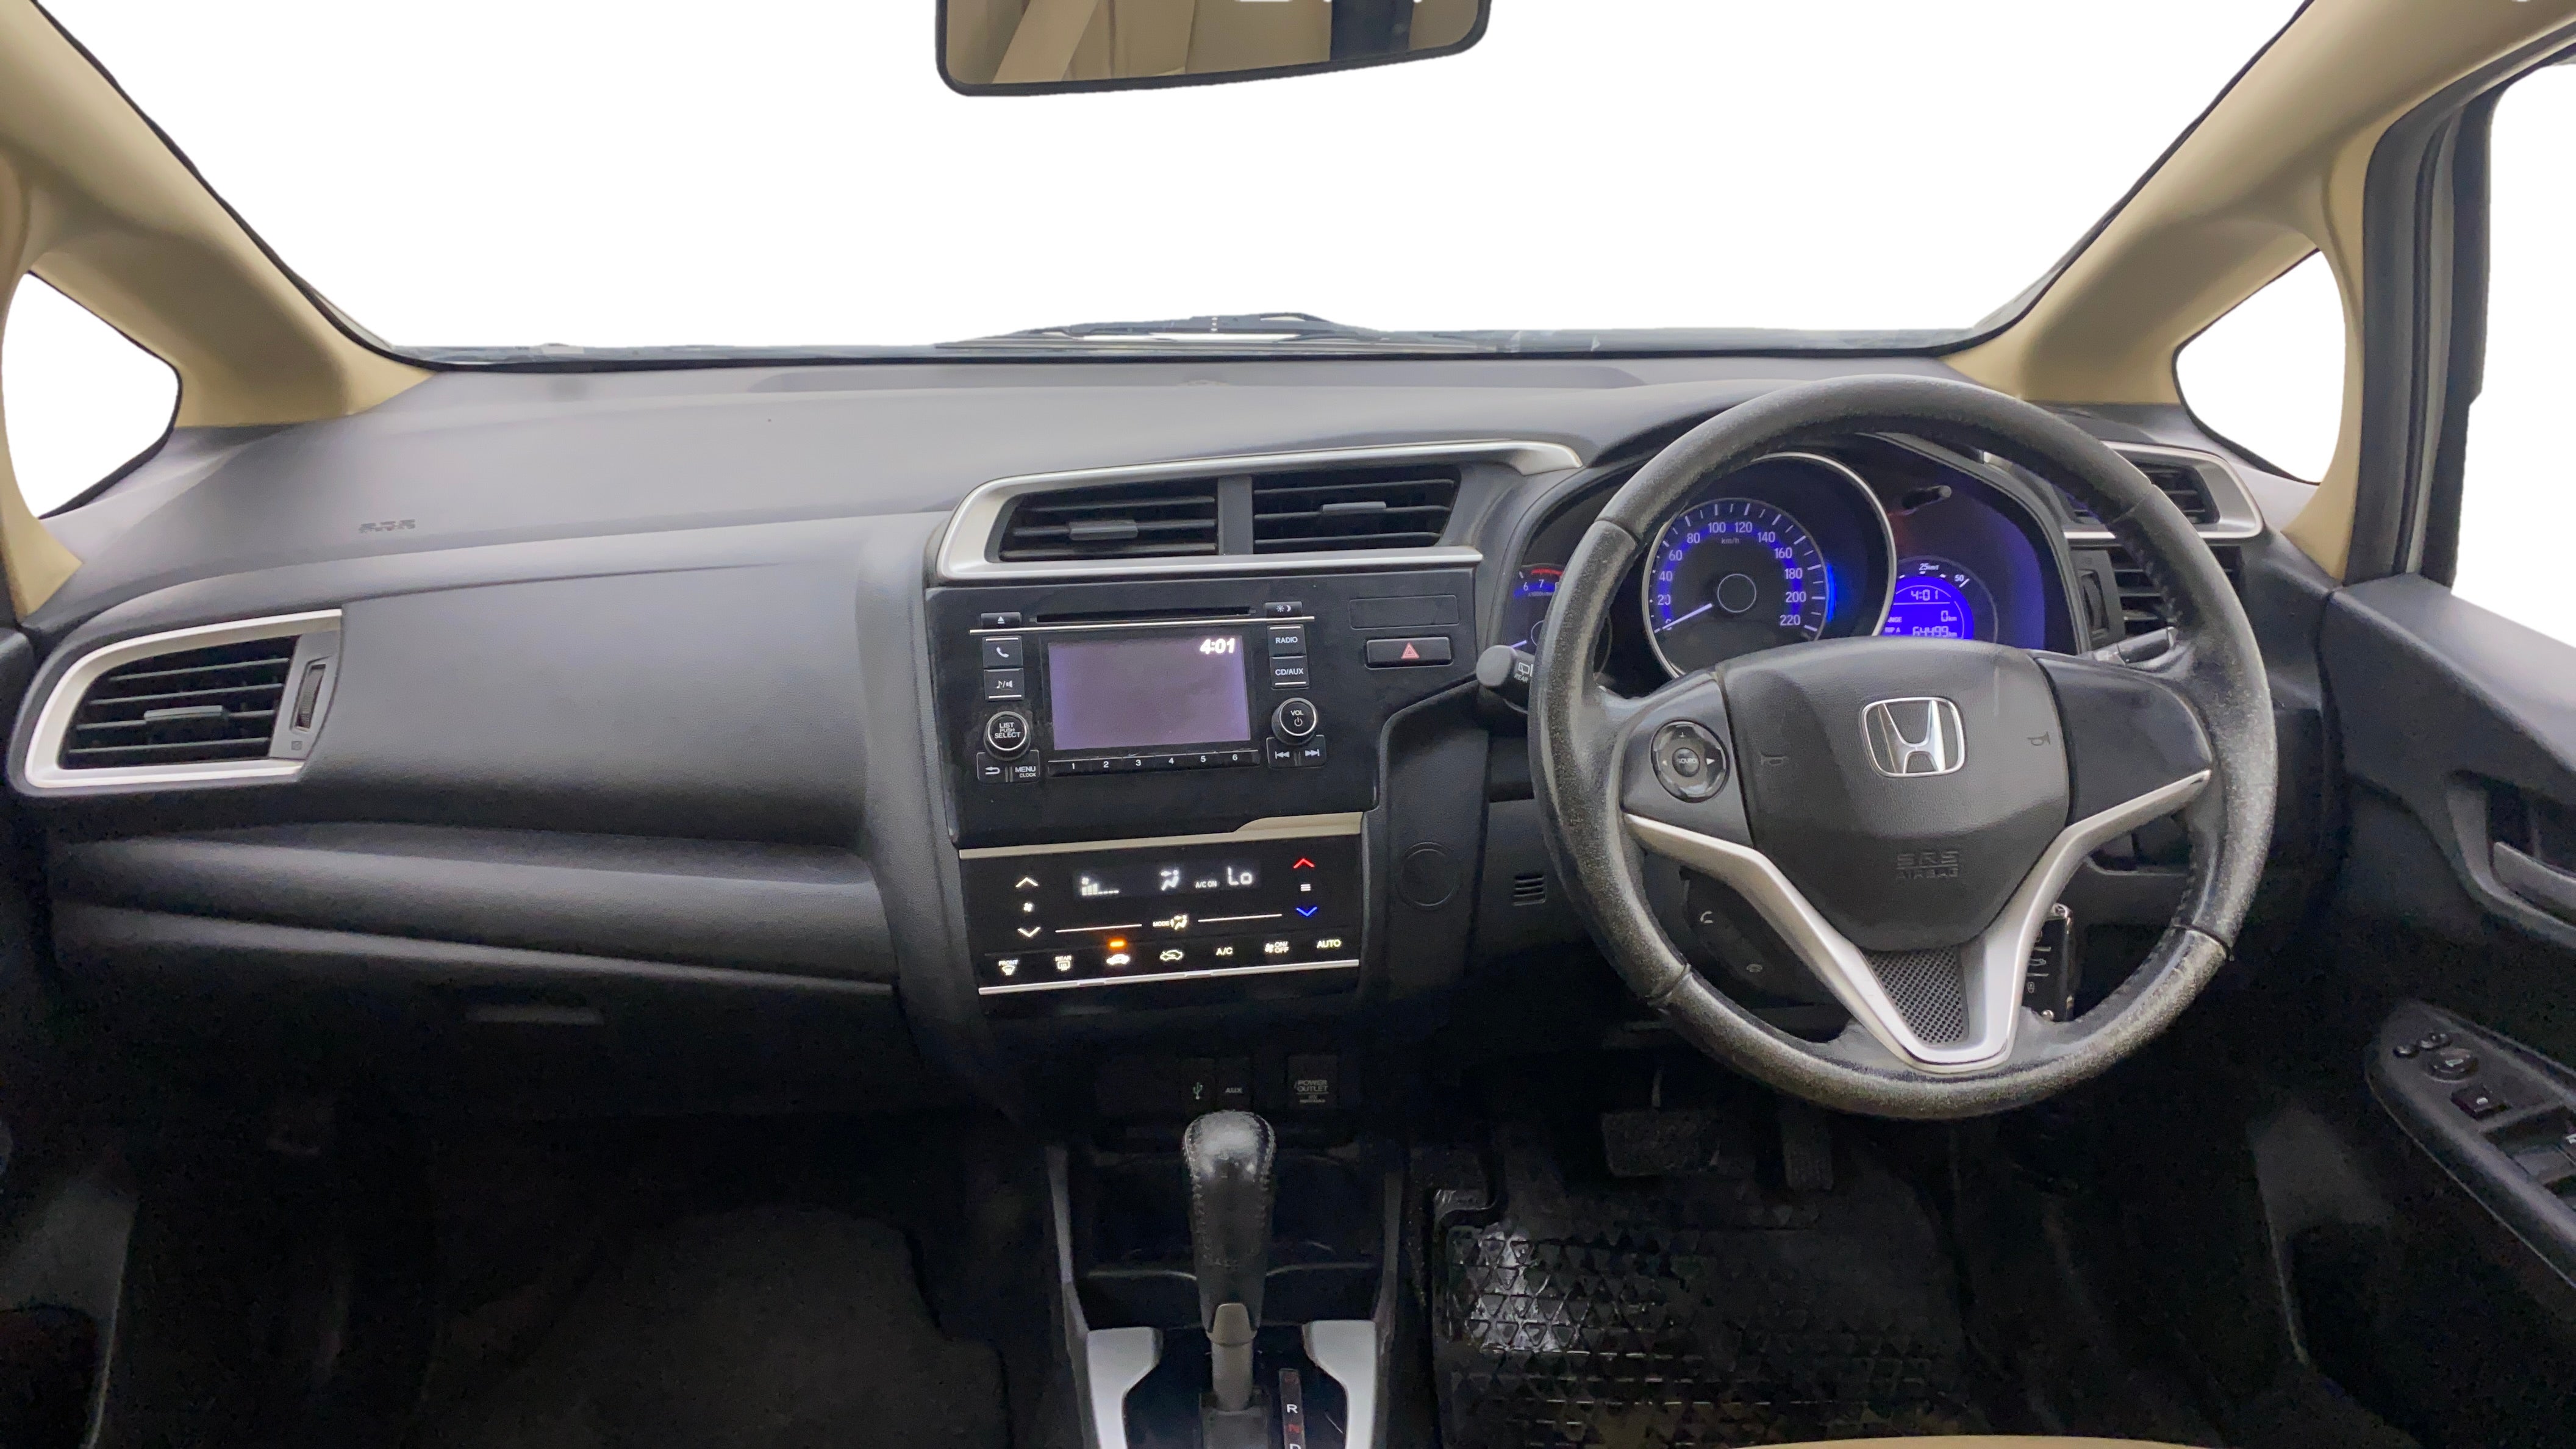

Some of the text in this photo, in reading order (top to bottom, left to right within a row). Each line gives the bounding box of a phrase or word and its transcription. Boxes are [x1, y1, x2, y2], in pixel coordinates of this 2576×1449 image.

[1708, 522, 1726, 533] 100
[1735, 521, 1753, 532] 120
[1687, 533, 1700, 544] 80
[1758, 532, 1776, 543] 140
[1669, 549, 1683, 561] 60
[1775, 547, 1792, 559] 160
[1659, 571, 1673, 581] 40
[1784, 568, 1803, 579] 180
[1523, 582, 1528, 591] 6
[1539, 579, 1544, 589] 7
[1658, 595, 1671, 606] 20
[1786, 592, 1806, 603] 200
[1911, 589, 1939, 601] 4:01
[1780, 615, 1801, 626] 220
[1200, 638, 1236, 654] 4:01
[1514, 673, 1528, 683] REAR
[1228, 867, 1252, 886] Lo
[1316, 939, 1341, 949] AUTO
[1216, 946, 1233, 956] A/C
[1286, 1404, 1298, 1414] R
